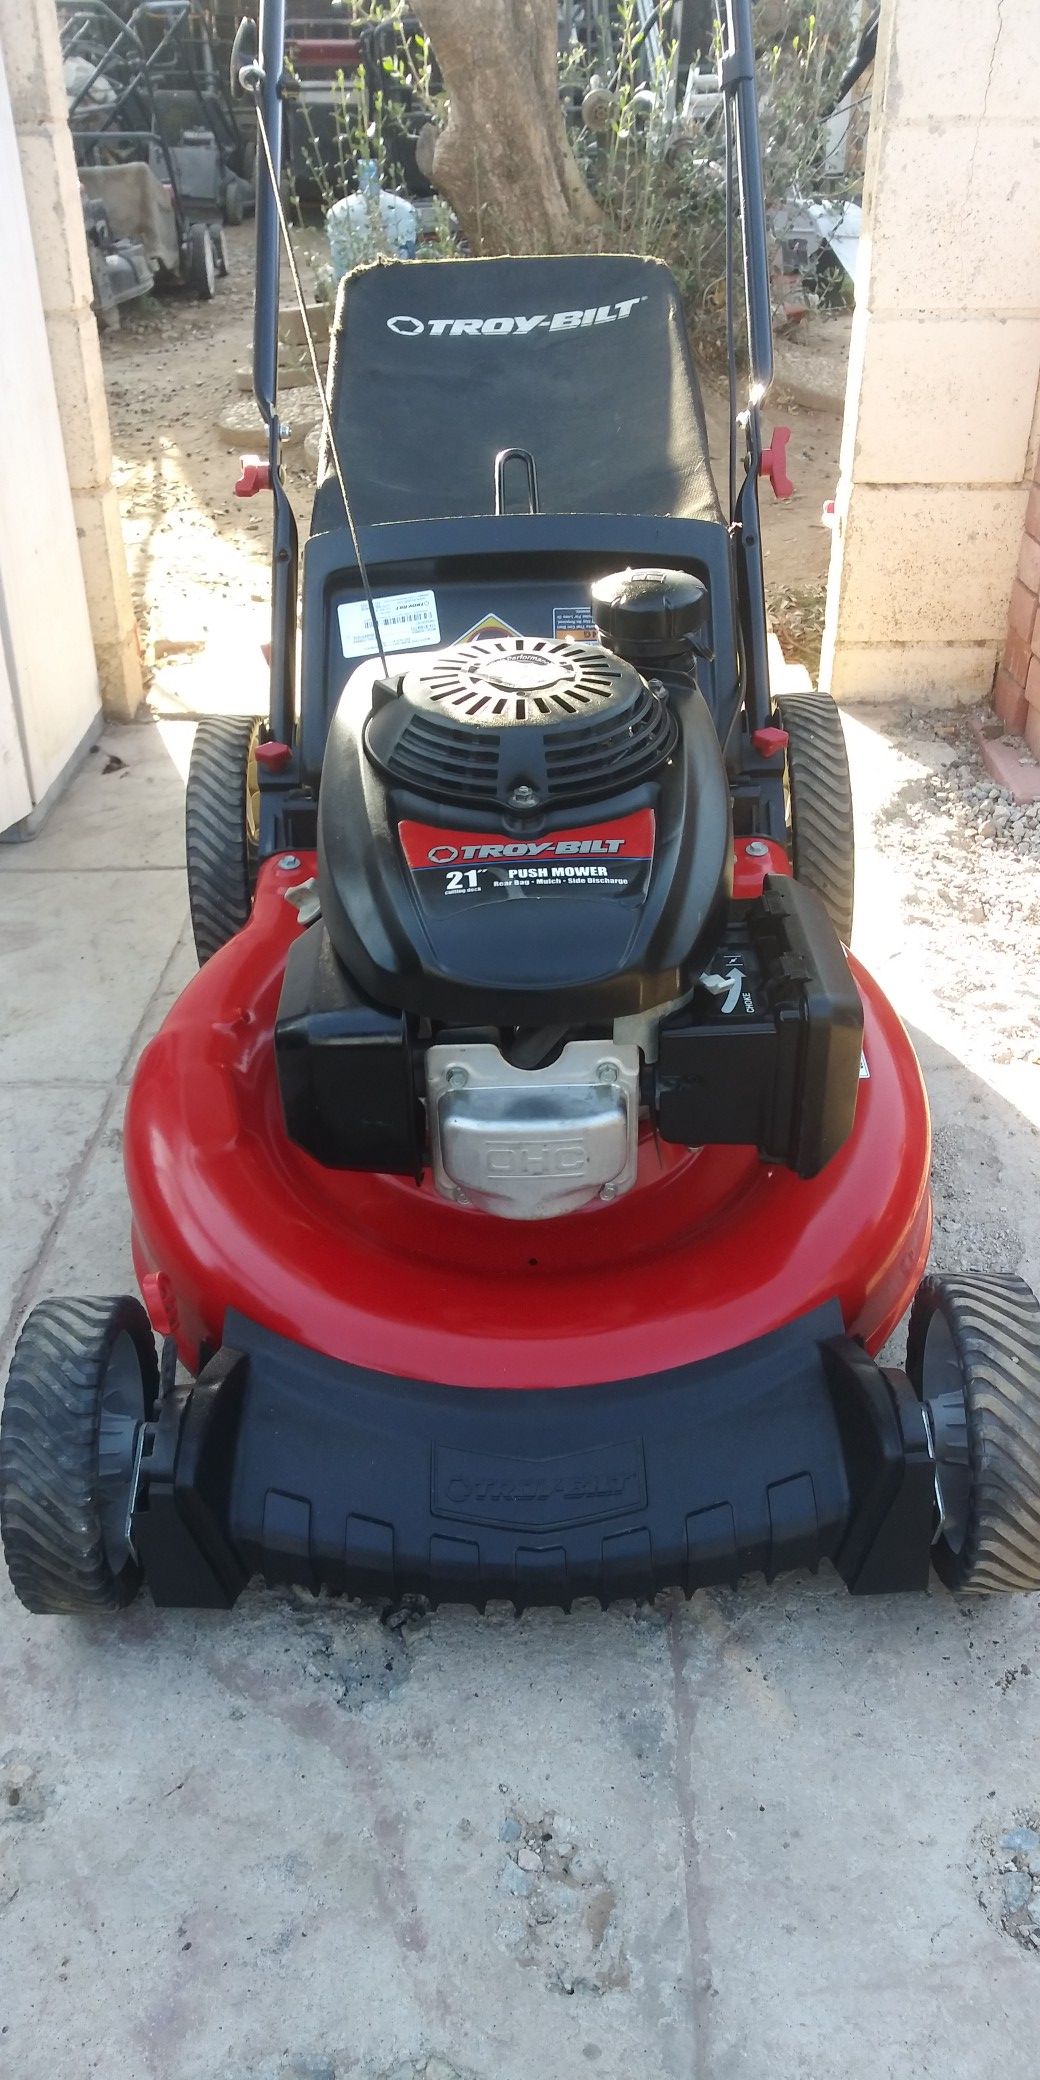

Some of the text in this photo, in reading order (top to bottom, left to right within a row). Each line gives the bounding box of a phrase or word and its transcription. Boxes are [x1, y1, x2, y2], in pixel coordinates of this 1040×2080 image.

[427, 297, 641, 336] TROY-BILT
[461, 839, 625, 860] TROY-BILT
[493, 877, 628, 888] Rear Bag Mulch Side Discharge
[508, 866, 608, 879] PUSH MOWER
[742, 992, 755, 1013] CHOKE
[486, 1146, 584, 1175] OHC
